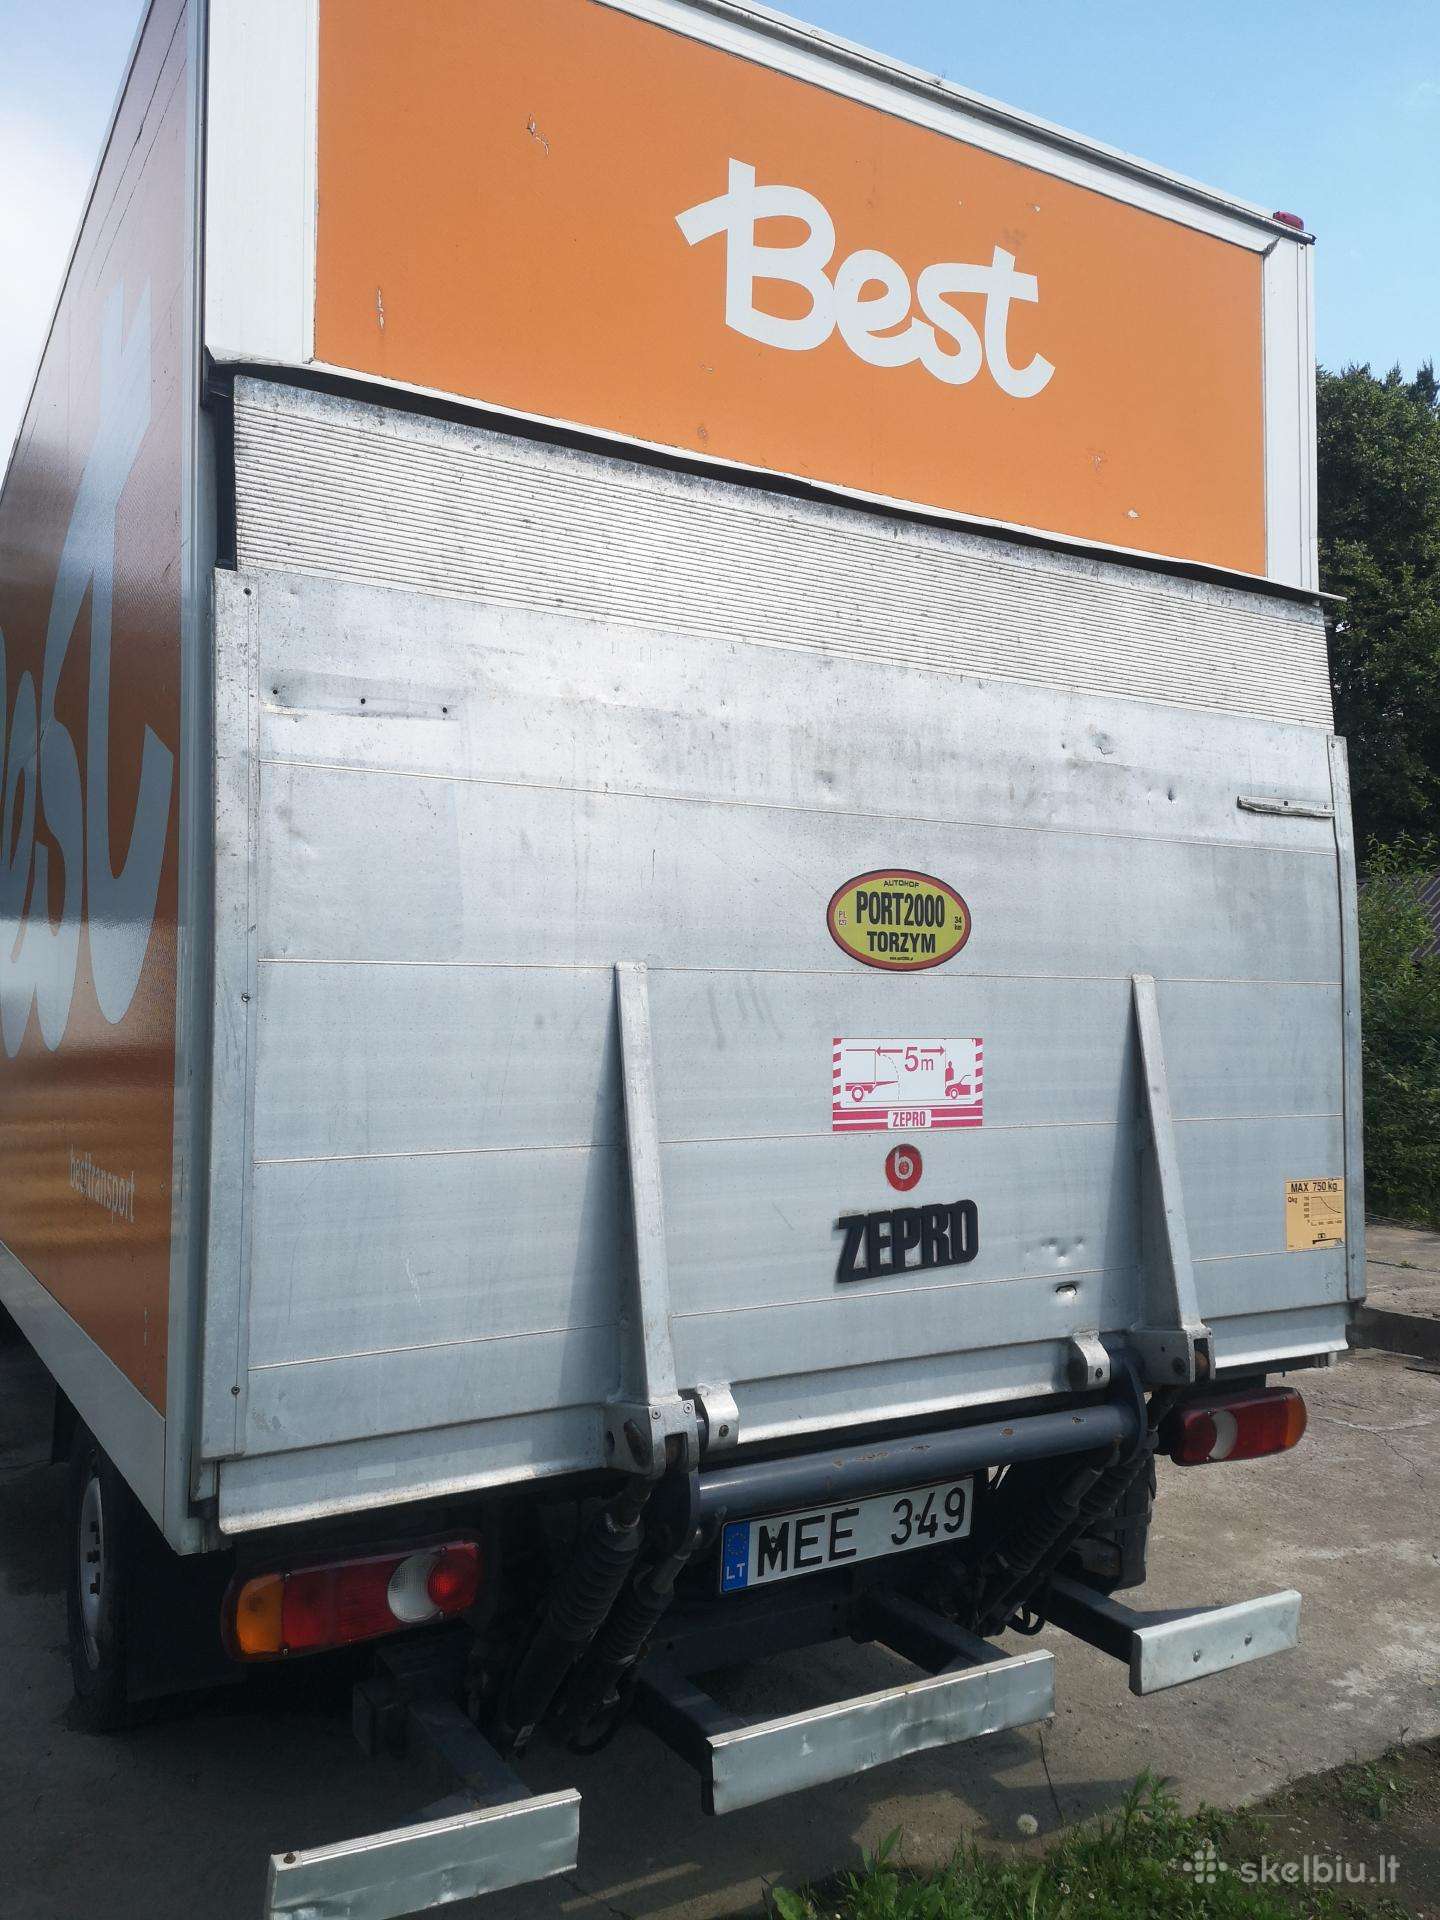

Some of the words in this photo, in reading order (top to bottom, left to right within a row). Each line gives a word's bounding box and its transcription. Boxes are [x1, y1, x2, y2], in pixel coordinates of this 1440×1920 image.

[675, 157, 1056, 398] Best
[0, 278, 174, 1059] est
[883, 879, 920, 888] AUTOHOF
[856, 890, 945, 928] PORT2000
[866, 930, 936, 953] TORZYM
[892, 1110, 926, 1127] ZEPRO
[1290, 1182, 1309, 1192] MAX
[1312, 1181, 1327, 1191] 750
[1328, 1181, 1338, 1192] kg
[836, 1199, 979, 1283] ZEPRO
[757, 1508, 860, 1577] MEE
[890, 1487, 966, 1546] 349
[725, 1562, 746, 1580] LT
